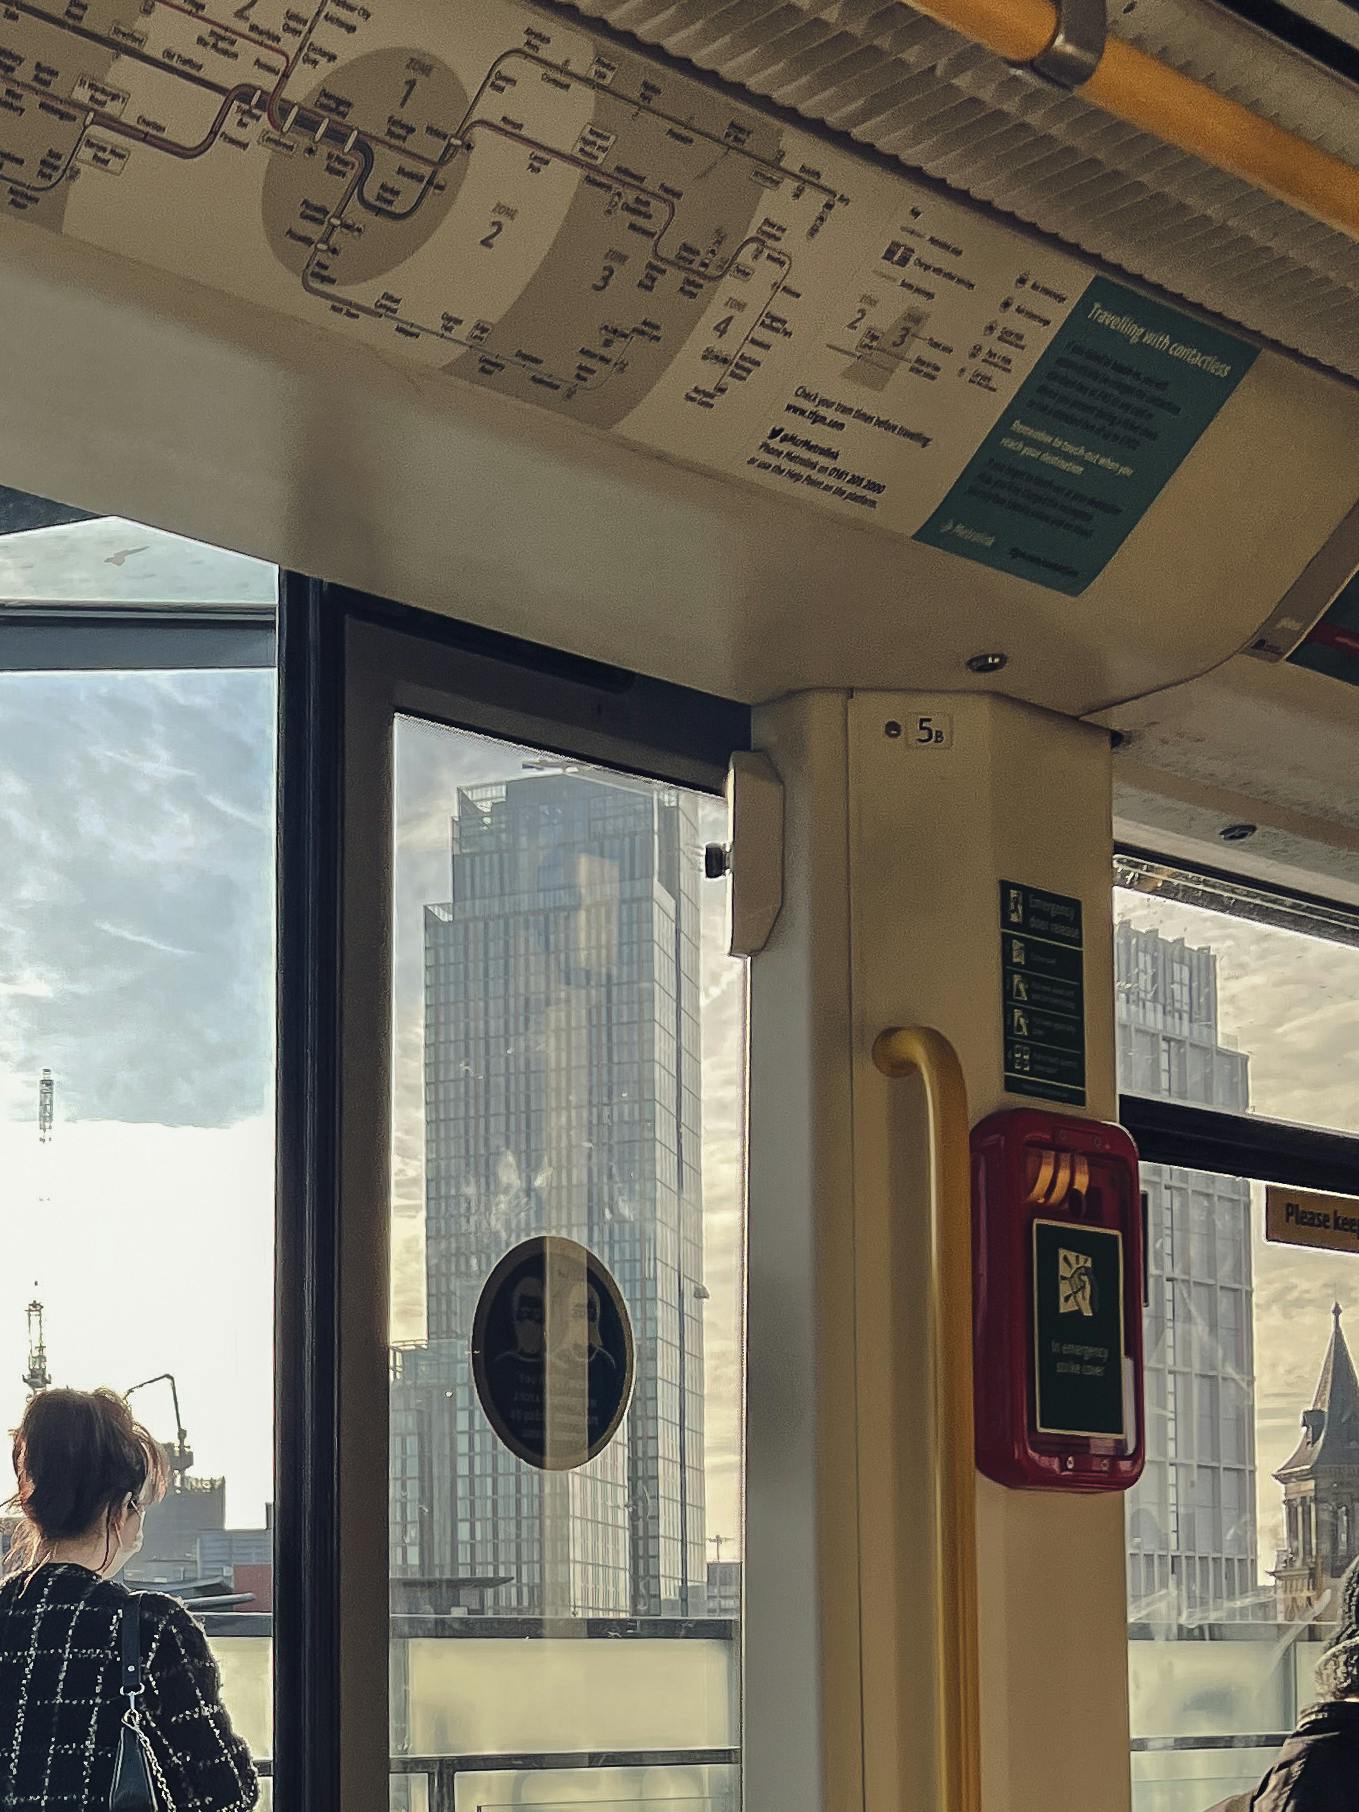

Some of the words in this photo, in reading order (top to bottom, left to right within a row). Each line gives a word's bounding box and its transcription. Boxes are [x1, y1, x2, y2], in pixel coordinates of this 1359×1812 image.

[400, 78, 417, 108] 1
[480, 220, 503, 249] 2
[591, 265, 615, 292] 3
[713, 315, 735, 338] 4
[1087, 302, 1145, 344] Travelling
[1143, 330, 1170, 351] with
[1168, 341, 1232, 378] contactless
[1285, 1203, 1331, 1229] Please
[1334, 1209, 1359, 1240] kee
